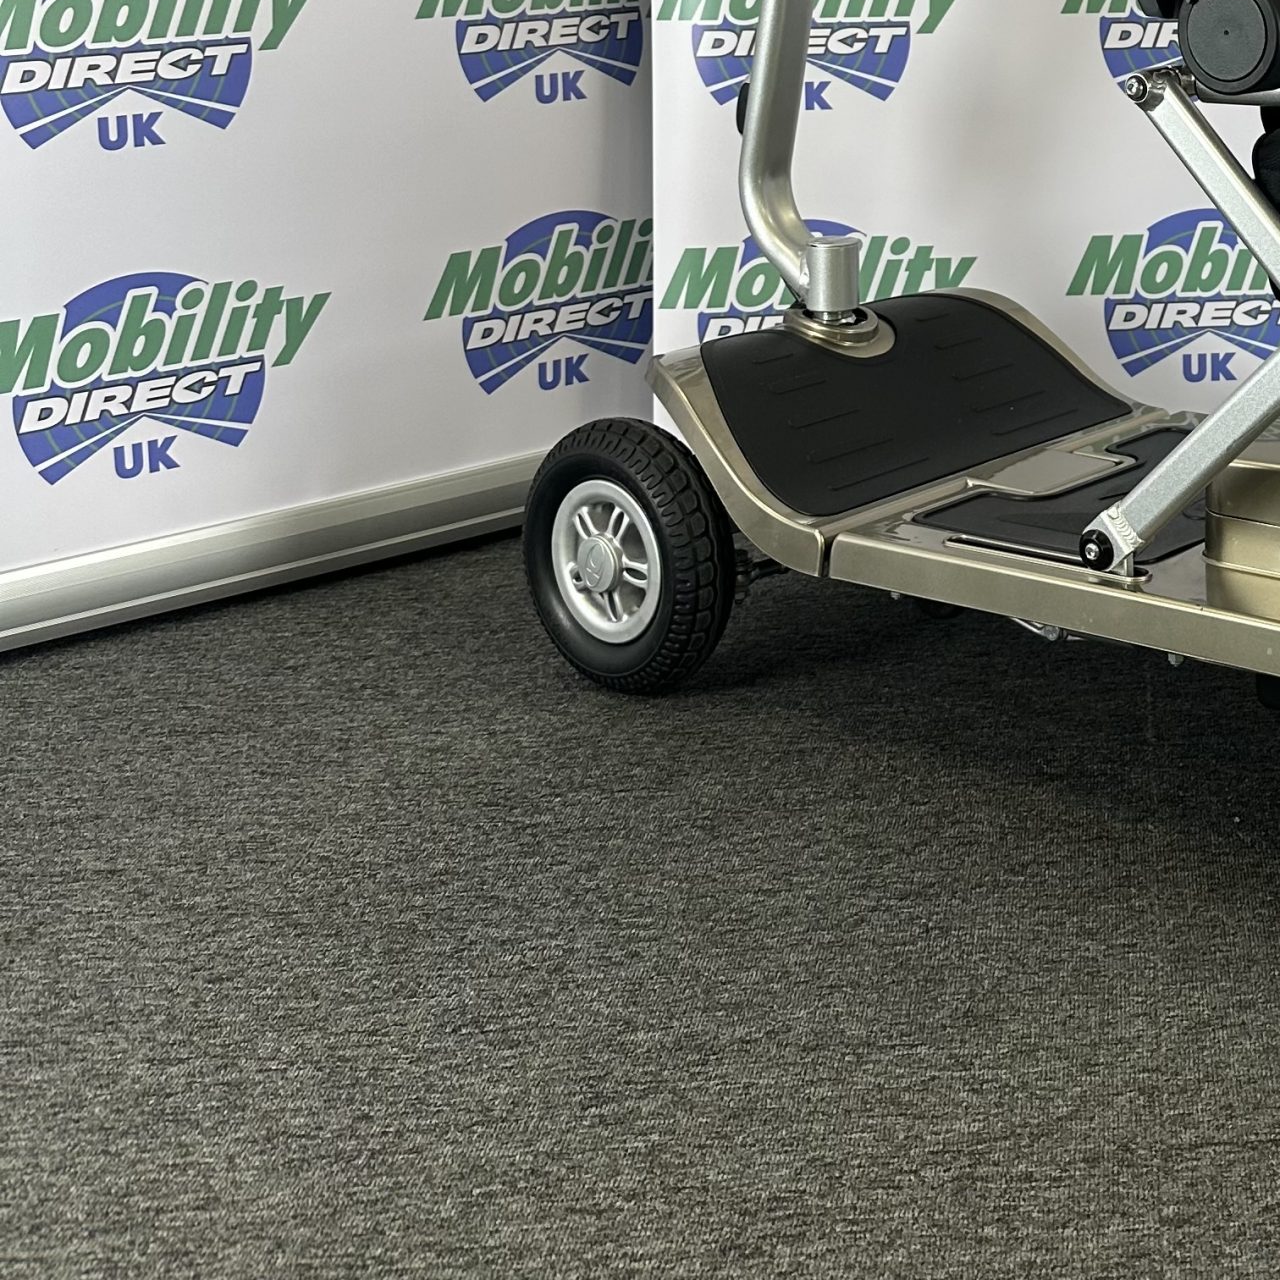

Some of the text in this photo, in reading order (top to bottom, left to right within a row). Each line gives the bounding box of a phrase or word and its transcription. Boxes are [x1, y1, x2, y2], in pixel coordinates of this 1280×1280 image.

[460, 12, 639, 54] DIRECT
[697, 26, 907, 58] DIECT
[1, 43, 248, 94] DIRECT
[534, 69, 588, 105] UK
[804, 81, 833, 110] K
[97, 111, 166, 151] UK
[423, 218, 653, 321] Mobili
[466, 291, 653, 351] DIRECT
[538, 353, 590, 391] UK
[1182, 352, 1238, 383] UK
[19, 362, 261, 434] DIRECT
[113, 435, 180, 479] UK
